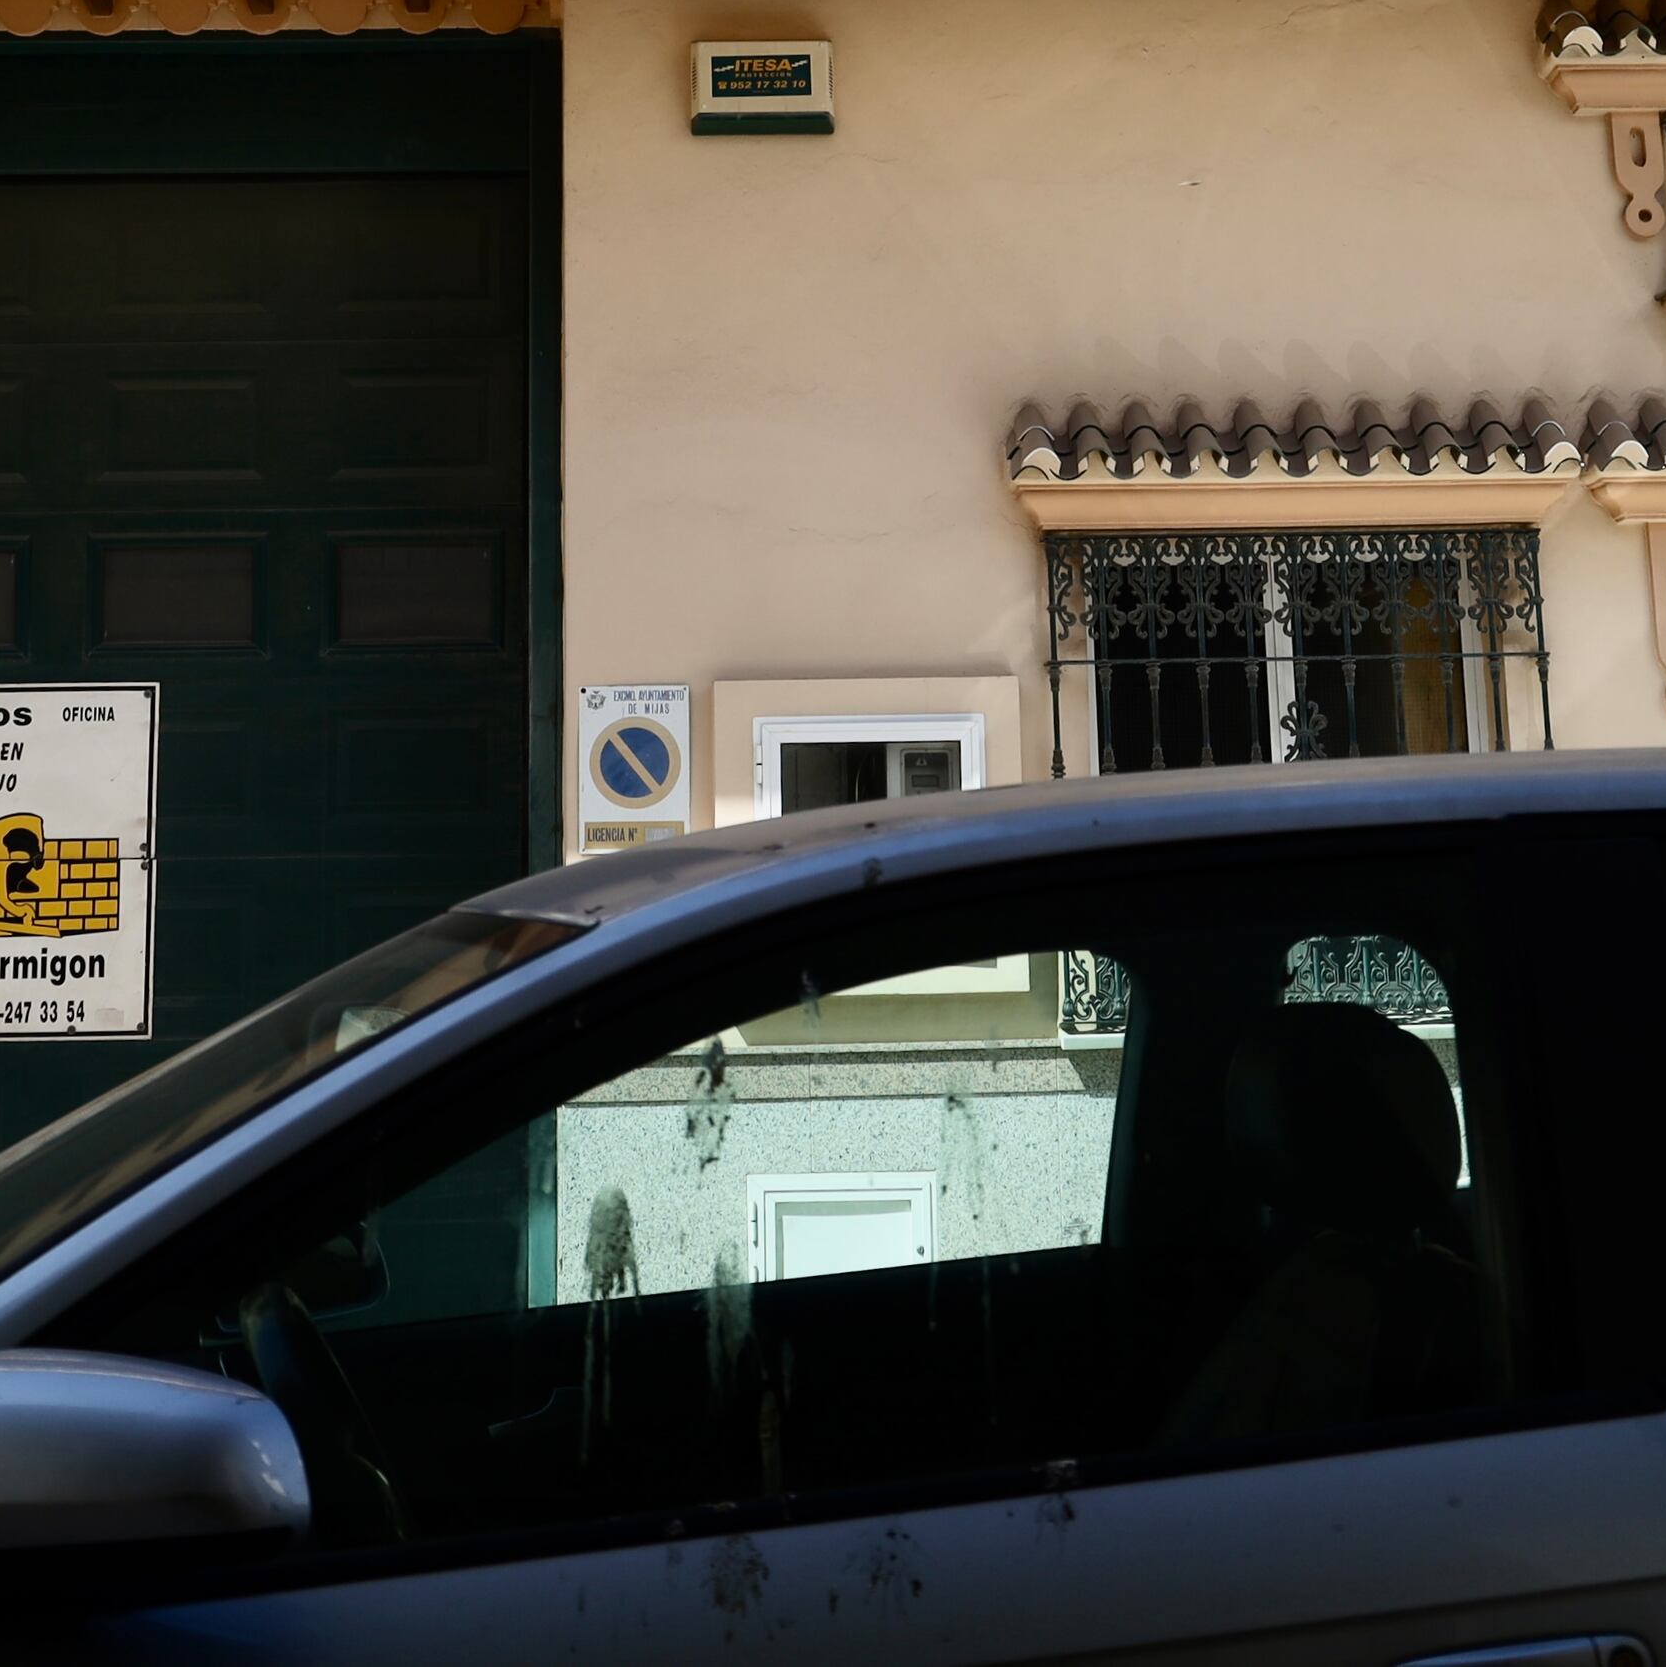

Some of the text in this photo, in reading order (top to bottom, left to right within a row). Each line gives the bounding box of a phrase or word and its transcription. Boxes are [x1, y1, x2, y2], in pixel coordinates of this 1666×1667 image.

[735, 59, 792, 71] ITESA
[730, 79, 806, 90] 952 17 32 10
[638, 690, 685, 701] AYUNTAMIENTO
[62, 706, 115, 722] OFICINA
[628, 703, 670, 714] DE MIJAS
[0, 742, 24, 761] EN
[587, 828, 626, 842] LICENCIA
[39, 1000, 58, 1023] 33
[66, 1000, 85, 1023] 54
